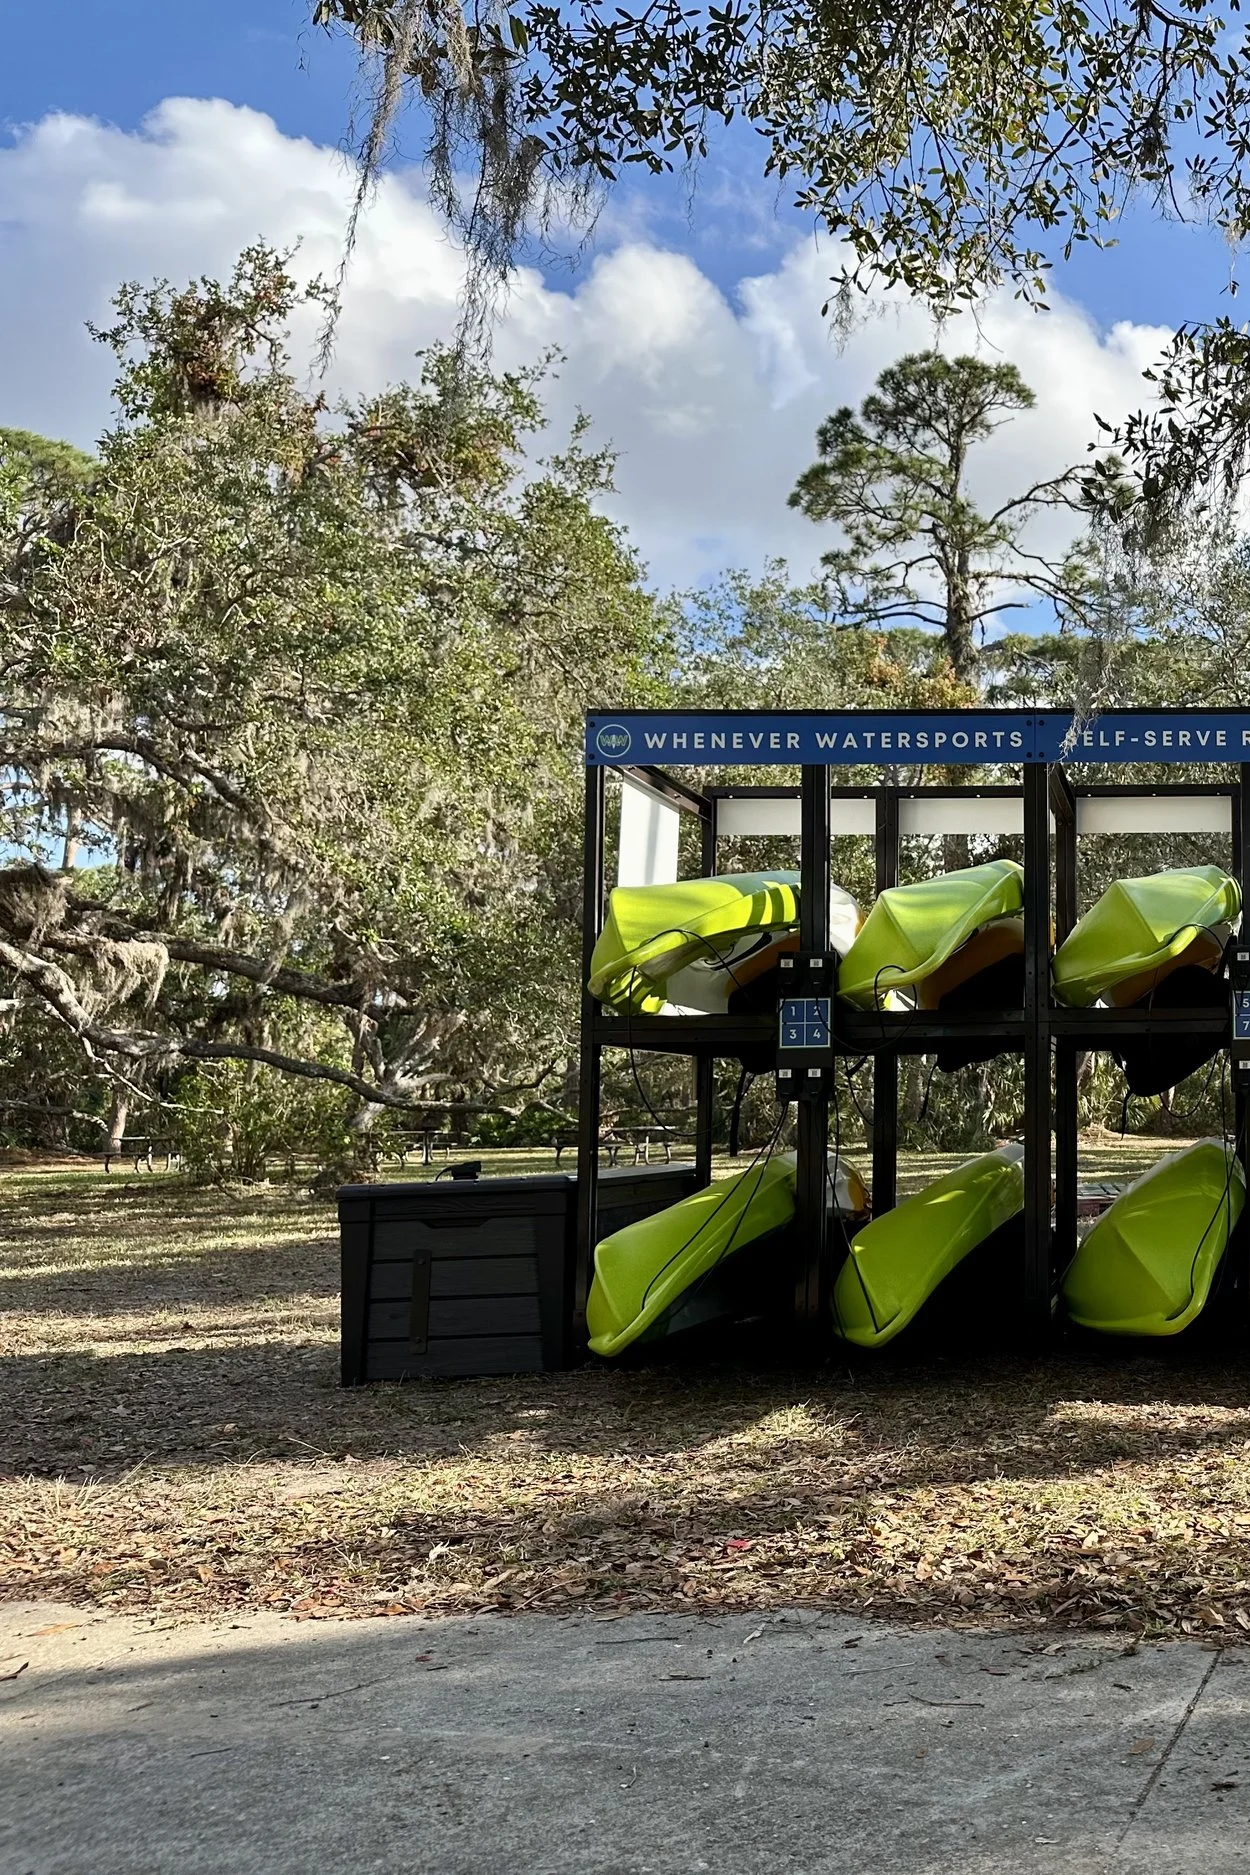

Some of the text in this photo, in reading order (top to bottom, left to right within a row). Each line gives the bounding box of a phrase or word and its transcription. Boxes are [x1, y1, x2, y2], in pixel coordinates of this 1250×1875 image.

[644, 731, 1023, 749] WHENEVER WATERSPORTS
[1066, 730, 1227, 746] ELF-SERVE
[1242, 998, 1250, 1008] 5
[790, 1005, 796, 1016] 1
[1242, 1020, 1250, 1031] 7
[789, 1029, 797, 1039] 3
[813, 1028, 821, 1039] 4
